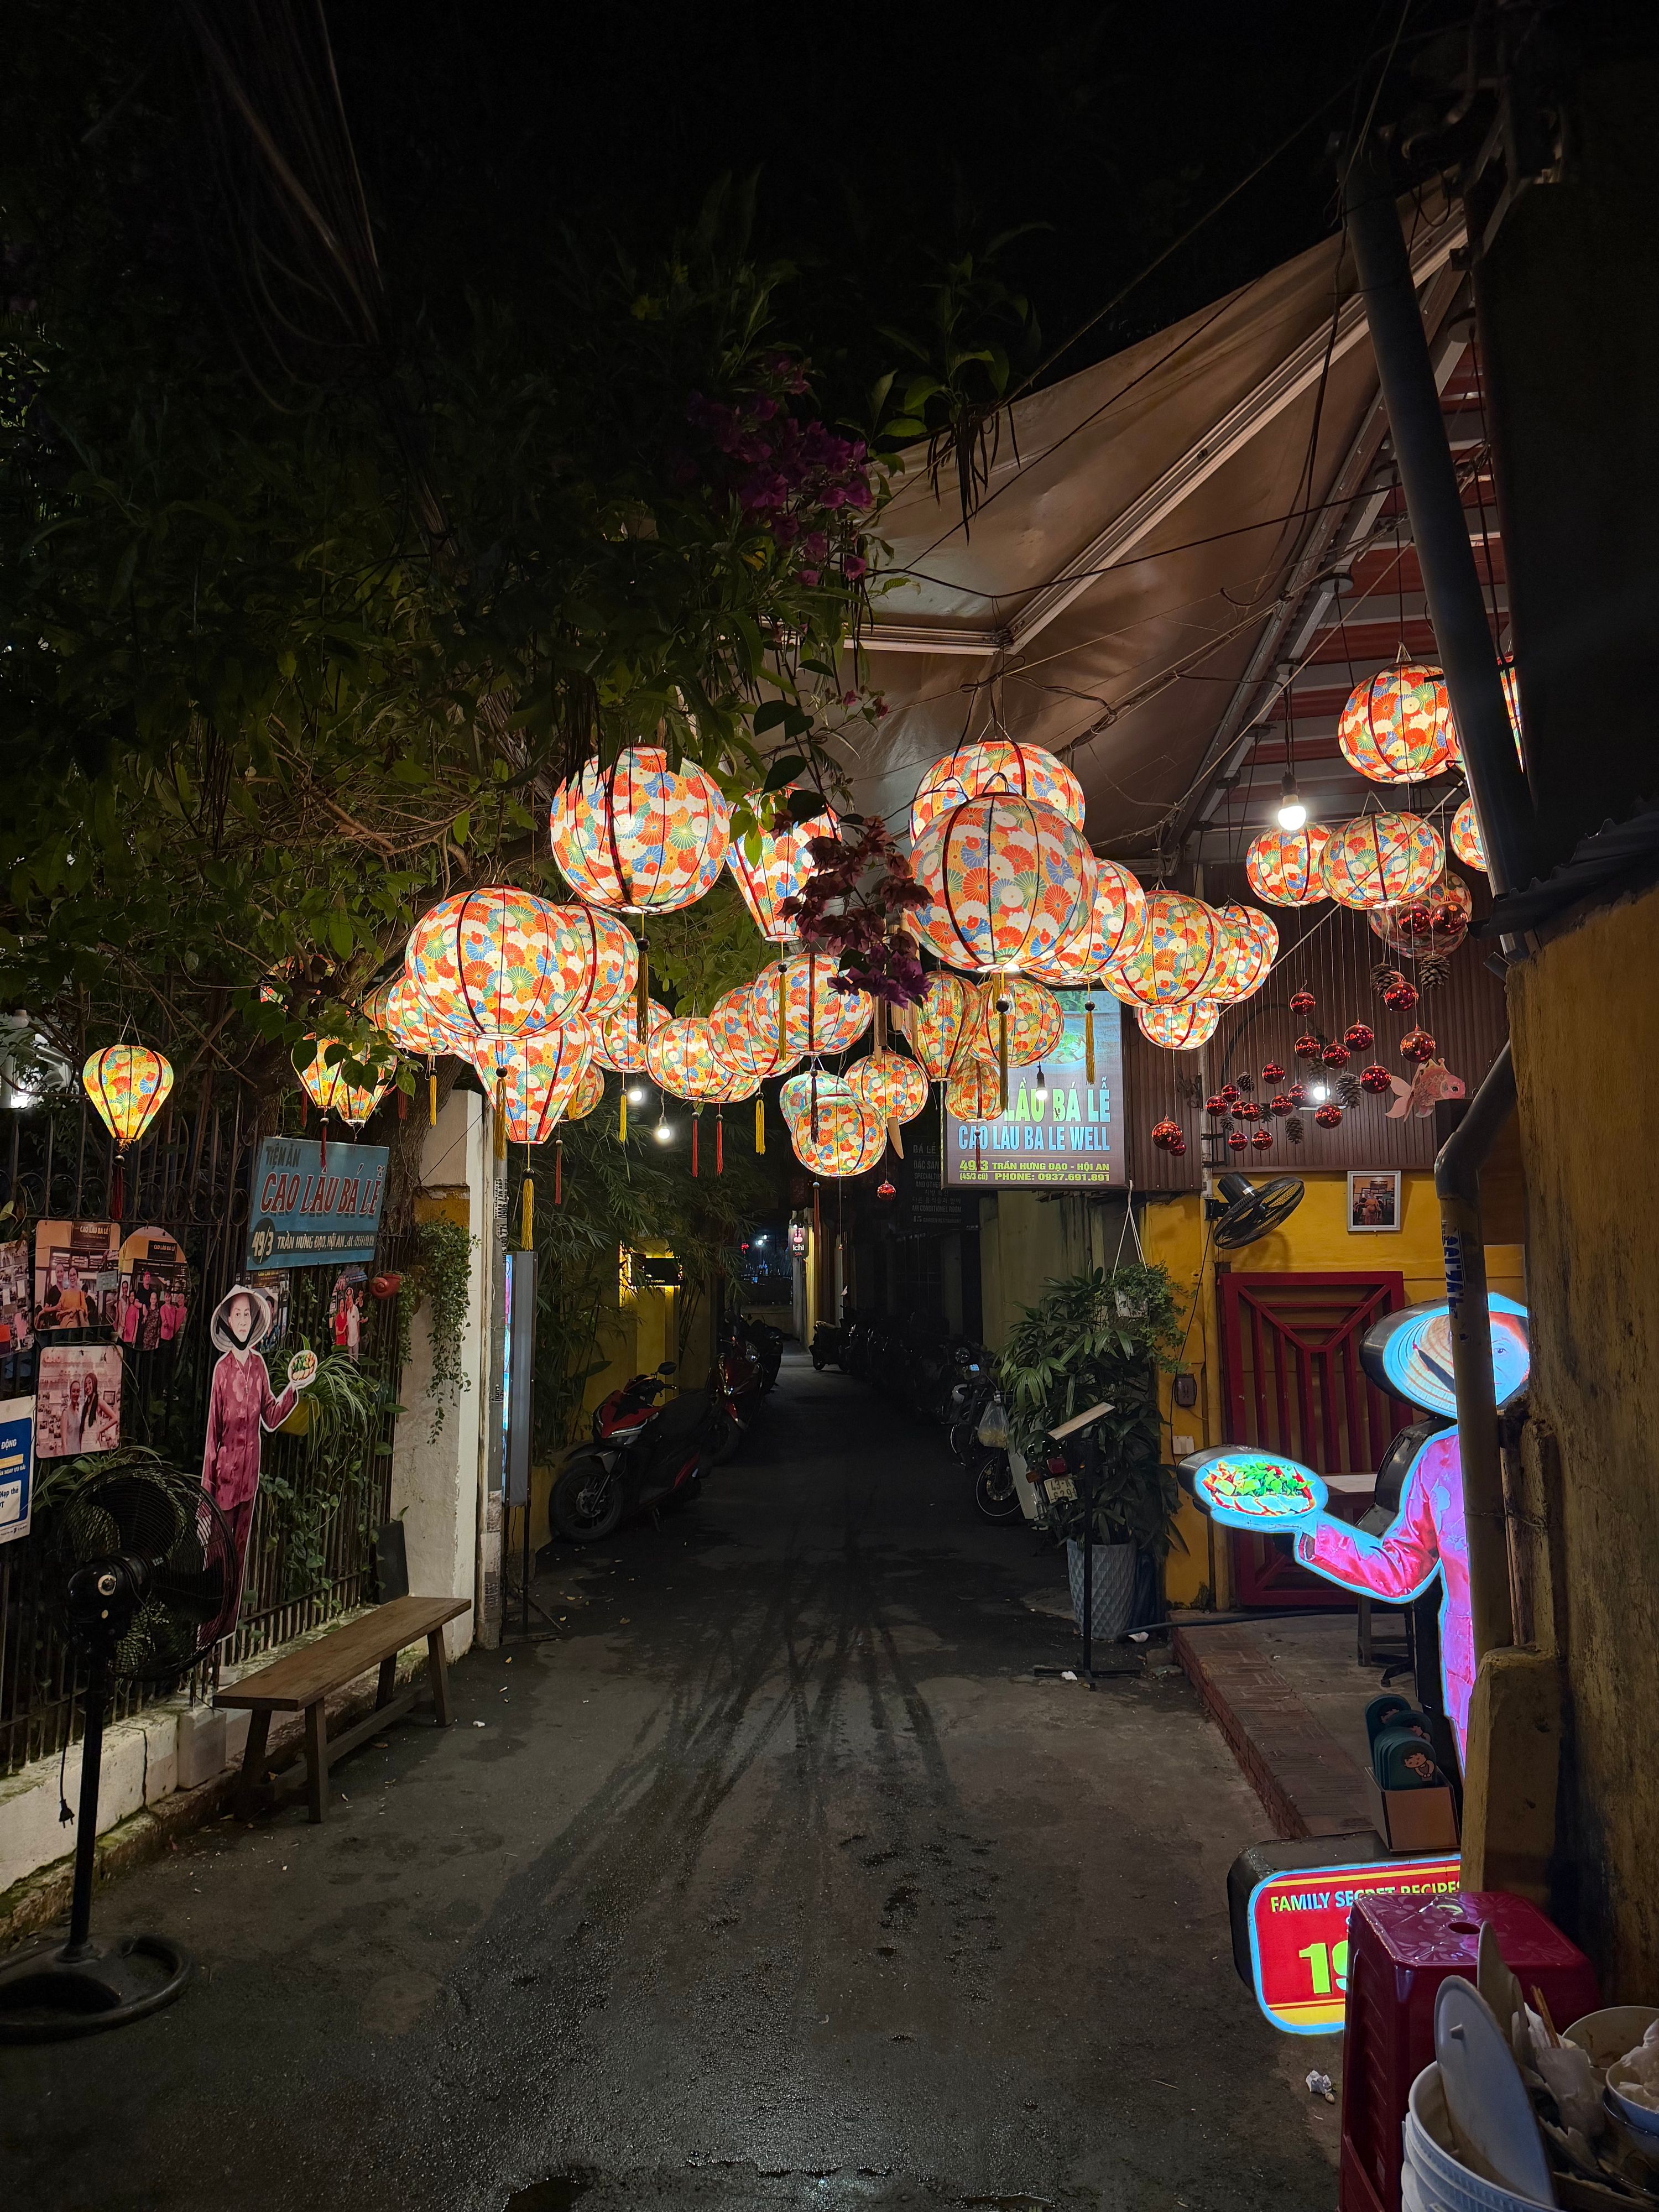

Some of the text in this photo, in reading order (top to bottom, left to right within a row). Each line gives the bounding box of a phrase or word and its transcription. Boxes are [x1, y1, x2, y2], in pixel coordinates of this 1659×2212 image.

[1052, 1082, 1081, 1123] BÁ
[958, 1125, 1110, 1151] CAO LAU BA LE WELL
[959, 1160, 988, 1171] 493
[260, 1172, 301, 1213] CAO
[336, 1164, 364, 1214] BÁ
[252, 1226, 274, 1263] 49/3
[1270, 1892, 1331, 1913] FAMILY
[1401, 1881, 1460, 1894] RECIPE
